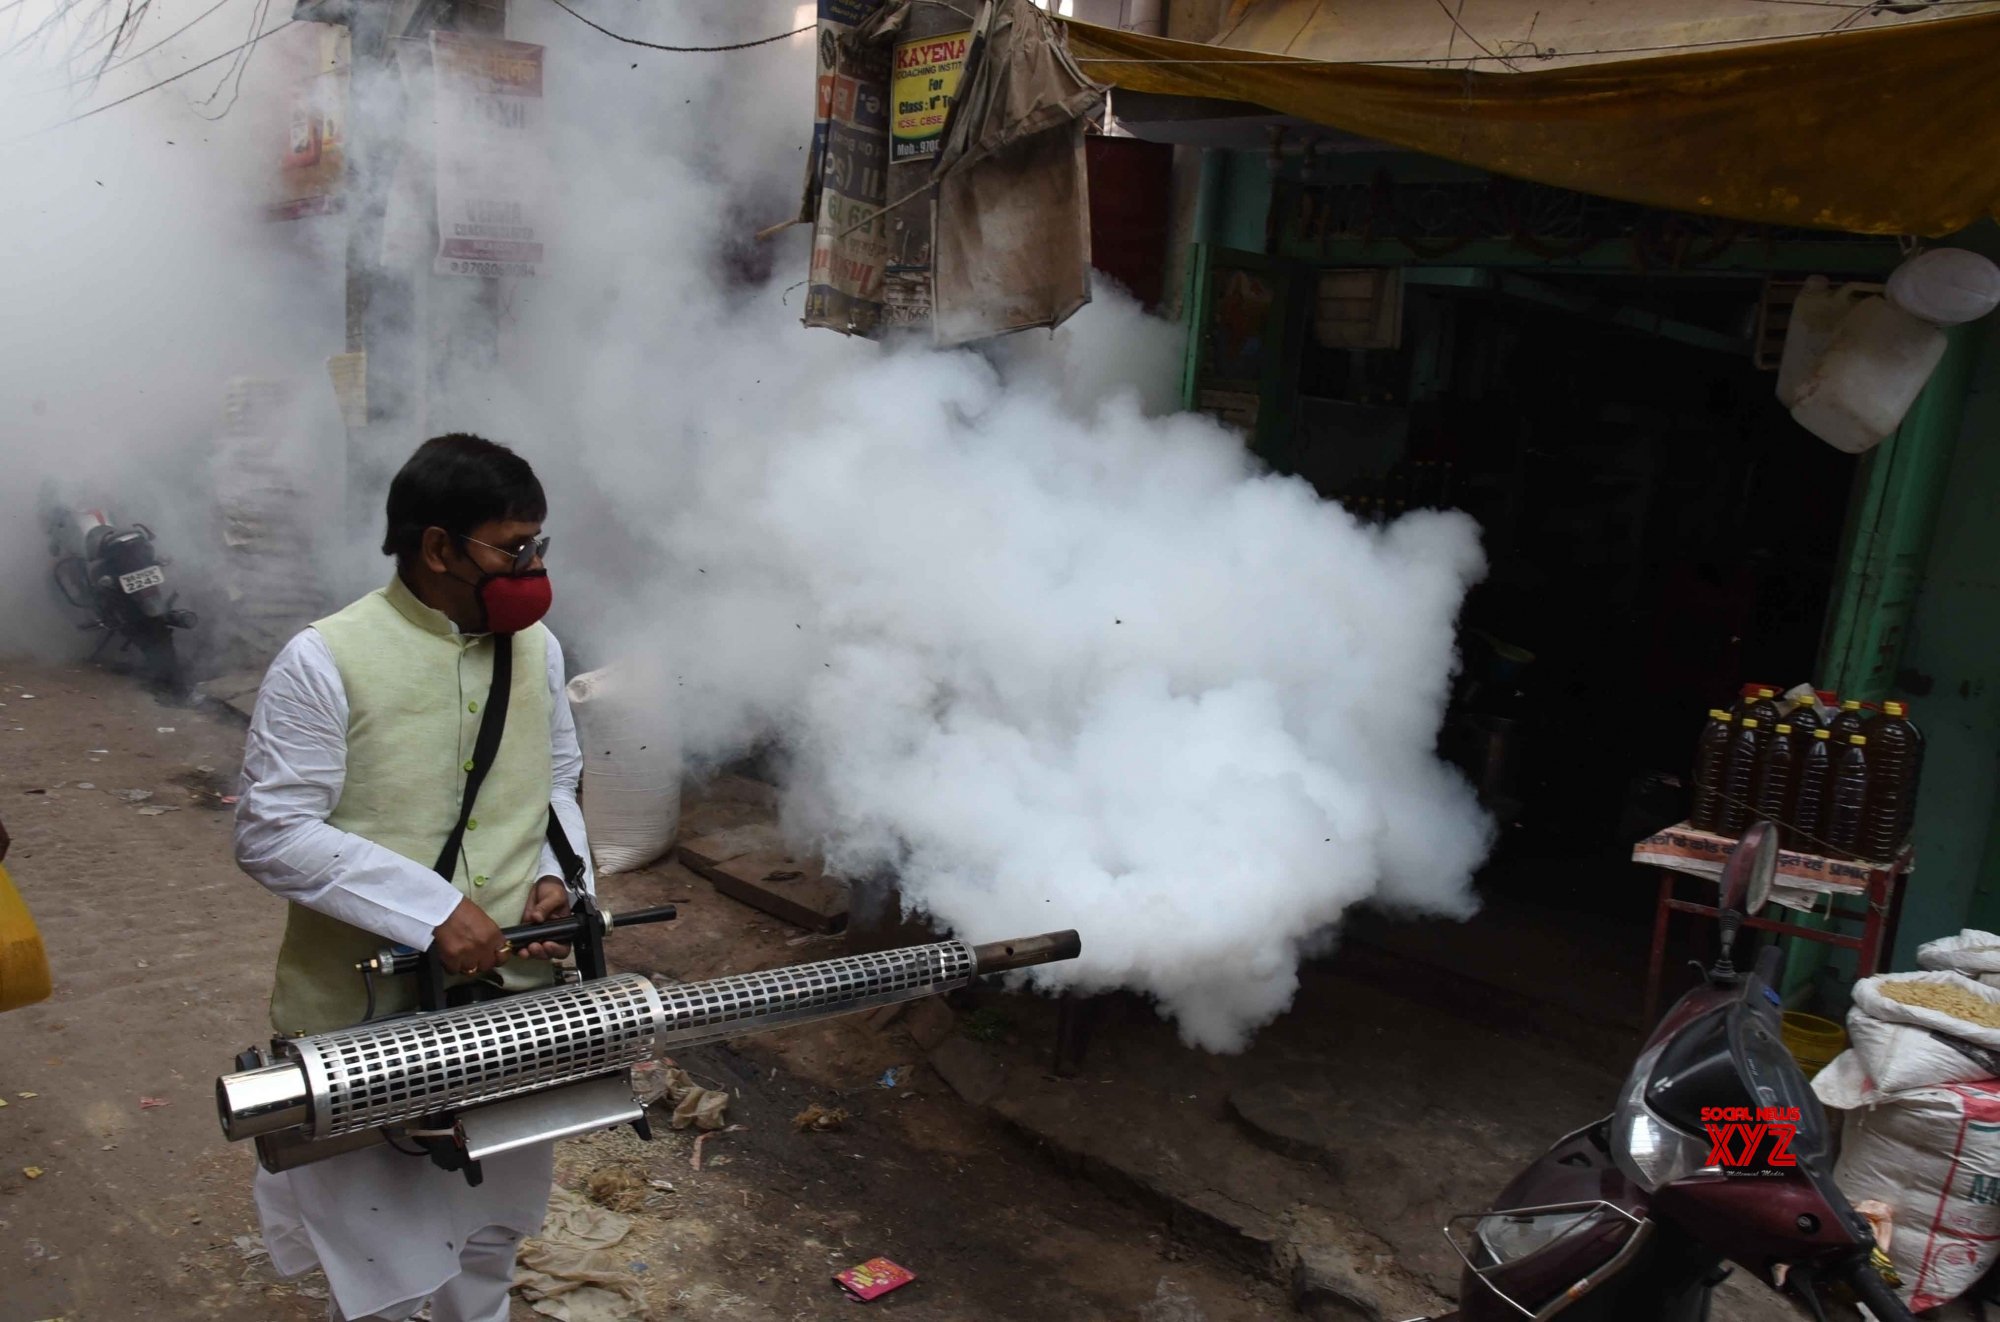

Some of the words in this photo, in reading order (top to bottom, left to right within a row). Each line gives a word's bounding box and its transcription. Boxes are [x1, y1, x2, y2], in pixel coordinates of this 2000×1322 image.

[897, 38, 966, 69] KAYENA
[896, 65, 937, 79] COACHING
[928, 78, 943, 92] For
